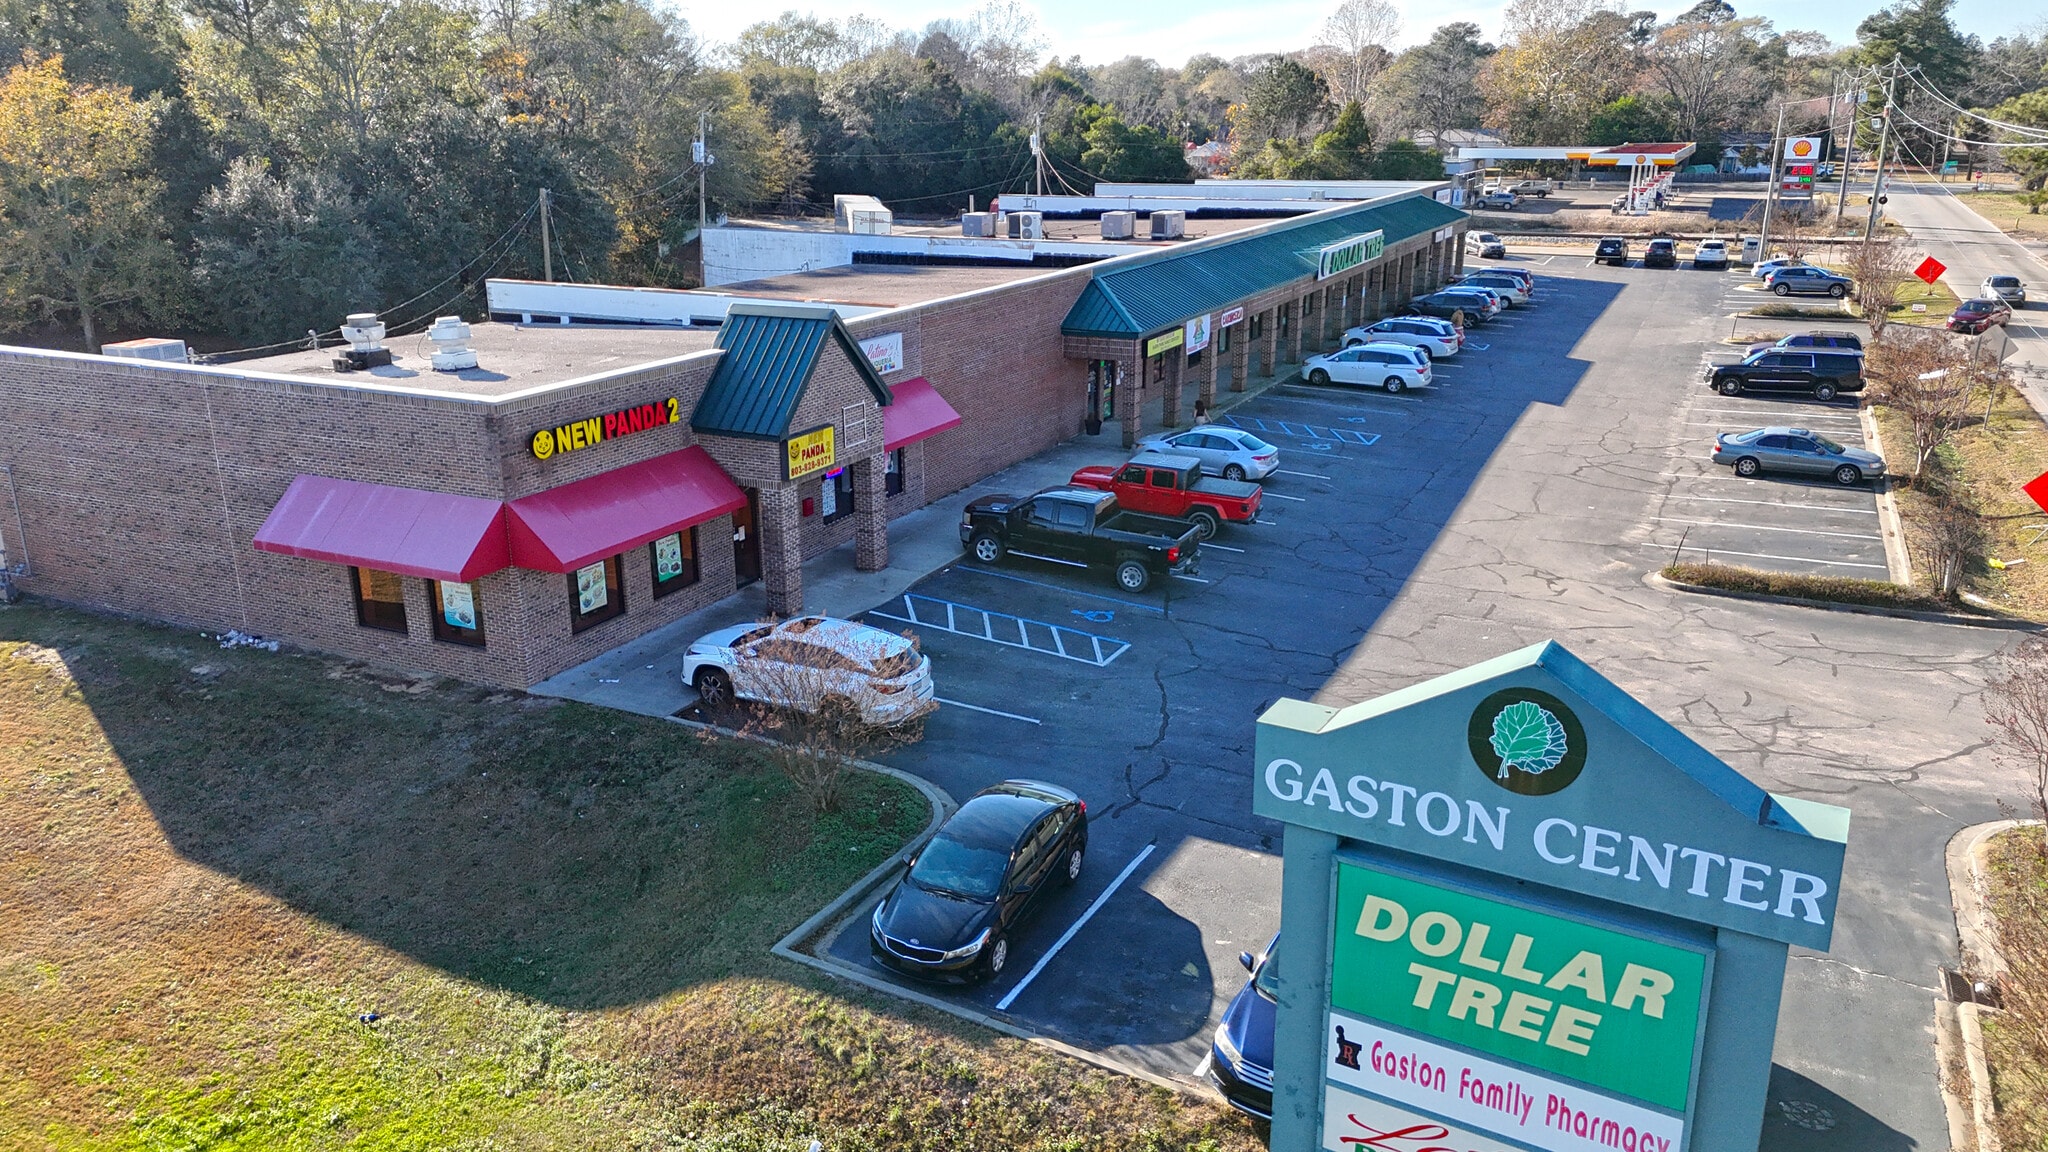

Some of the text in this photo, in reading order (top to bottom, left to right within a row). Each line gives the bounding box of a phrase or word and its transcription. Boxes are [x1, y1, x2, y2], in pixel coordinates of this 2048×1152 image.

[1330, 234, 1384, 274] DOLLAR TREE
[554, 397, 680, 454] NEW PANDA 2
[801, 441, 831, 461] PANDA 2
[808, 430, 824, 443] NEW
[1263, 757, 1829, 926] GASTON CENTER
[1354, 894, 1676, 1020] DOLLAR
[1407, 961, 1603, 1057] TREE
[1371, 1040, 1446, 1093] Gaston
[1458, 1068, 1535, 1127] Family
[1545, 1093, 1671, 1152] Pharmacy
